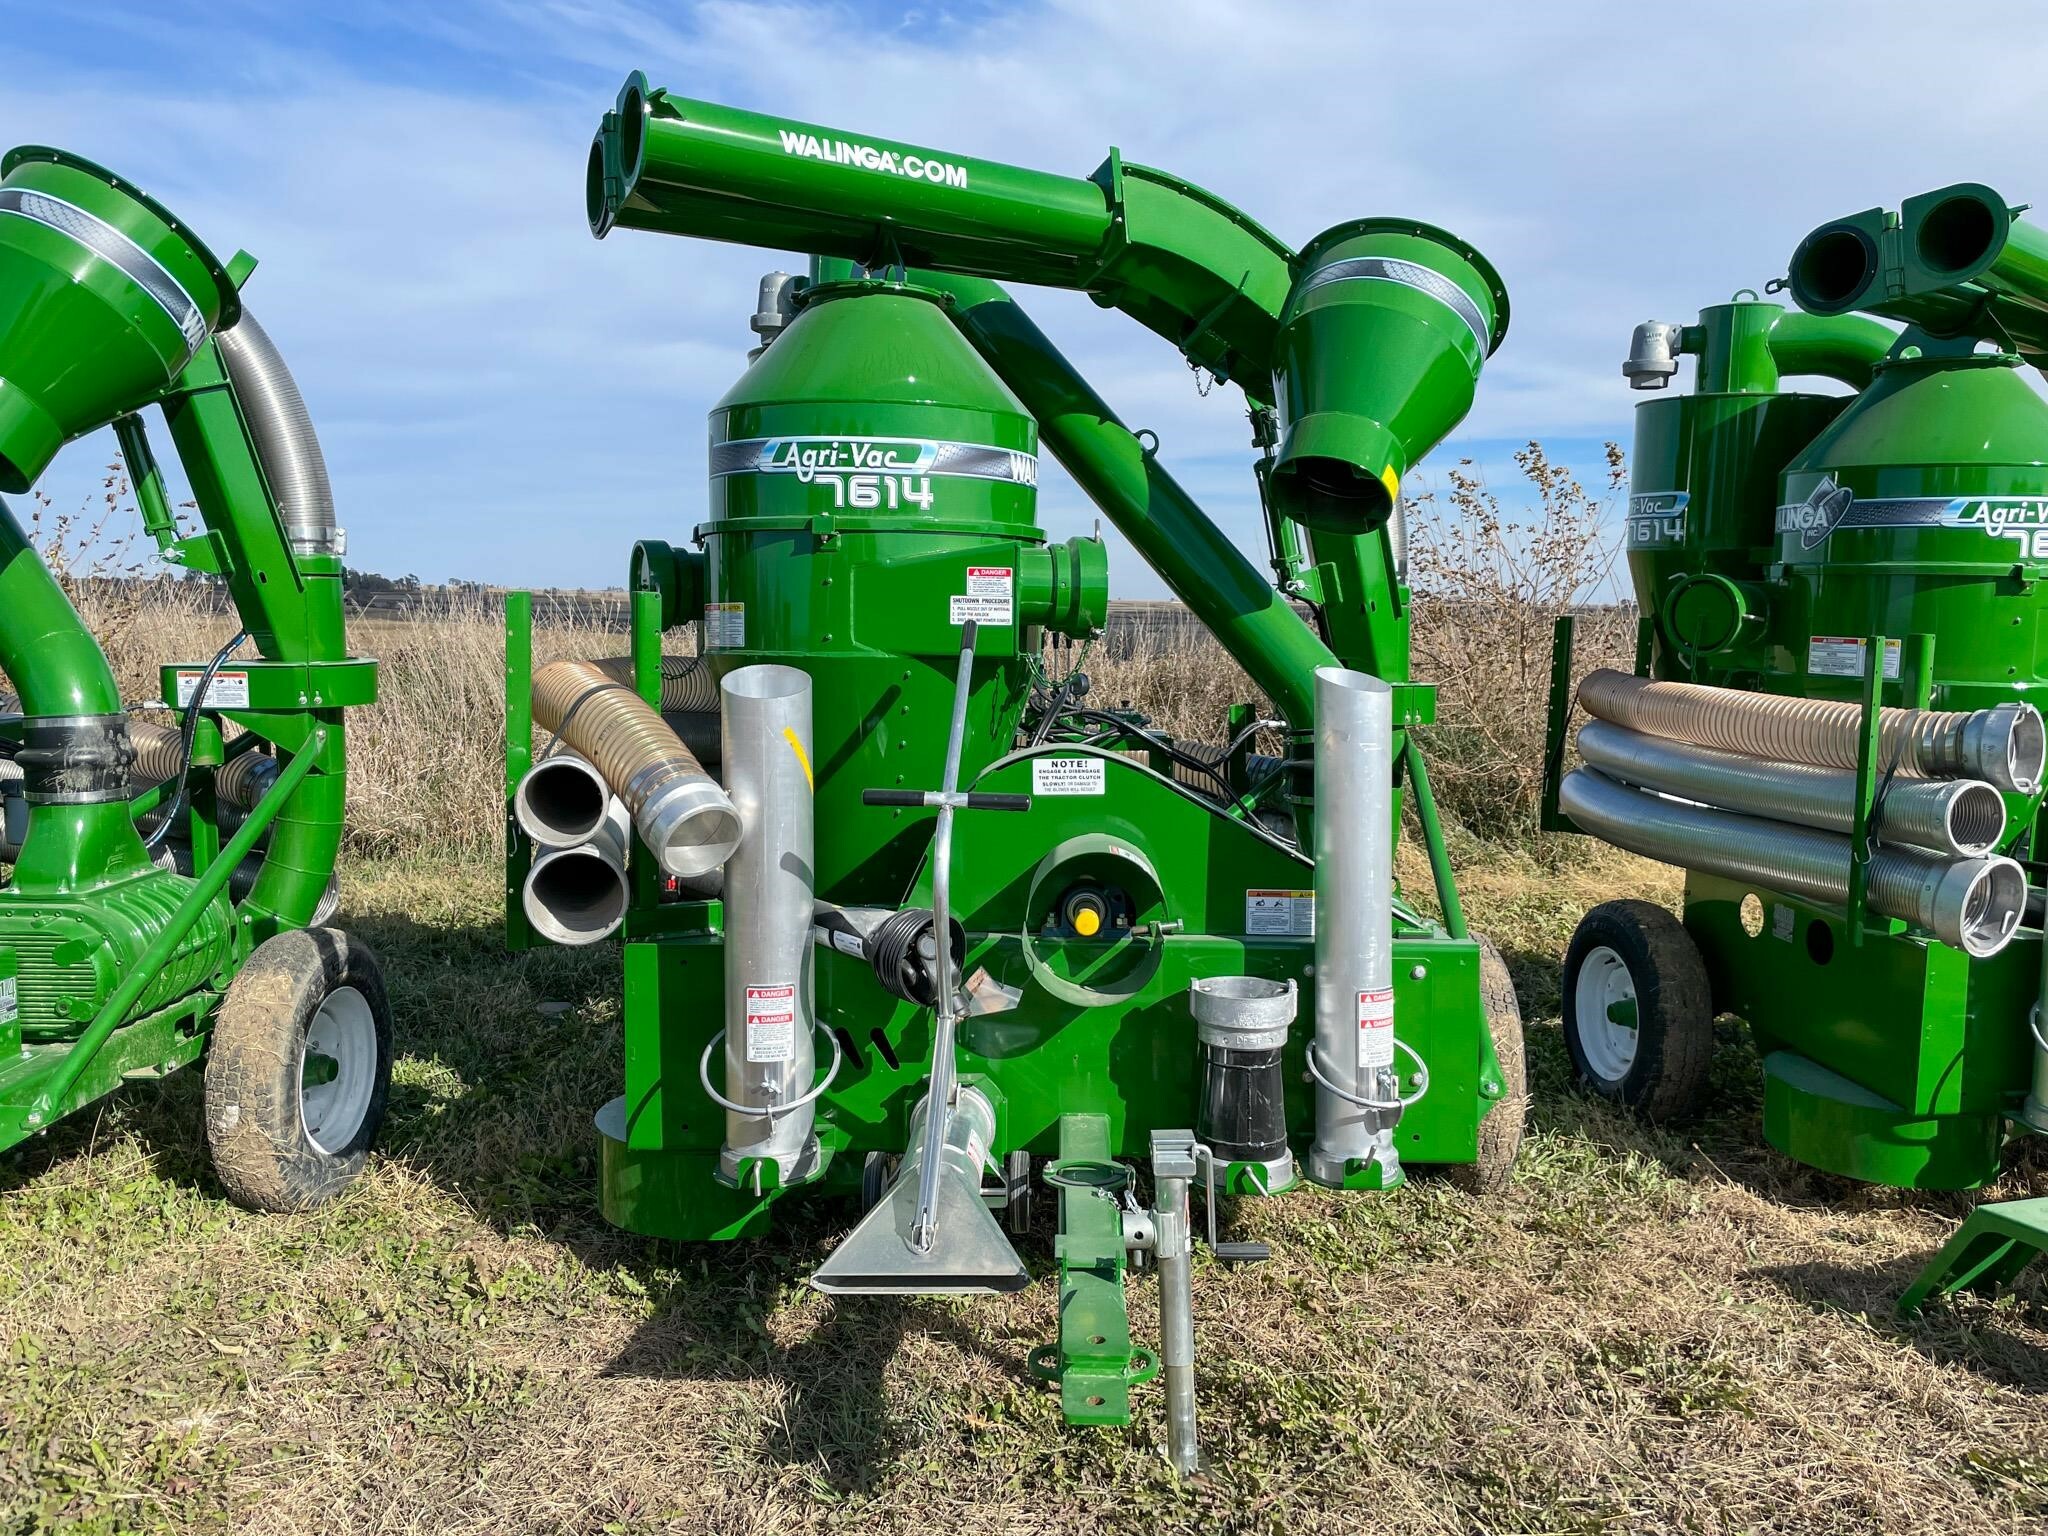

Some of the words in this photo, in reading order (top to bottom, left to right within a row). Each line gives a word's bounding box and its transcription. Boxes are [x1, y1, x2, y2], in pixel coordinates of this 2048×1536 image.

[784, 441, 899, 483] Agri-Vac
[813, 475, 934, 511] 7614
[1051, 760, 1088, 768] NOTE!
[761, 989, 790, 998] DANGER
[761, 1015, 790, 1023] DANGER
